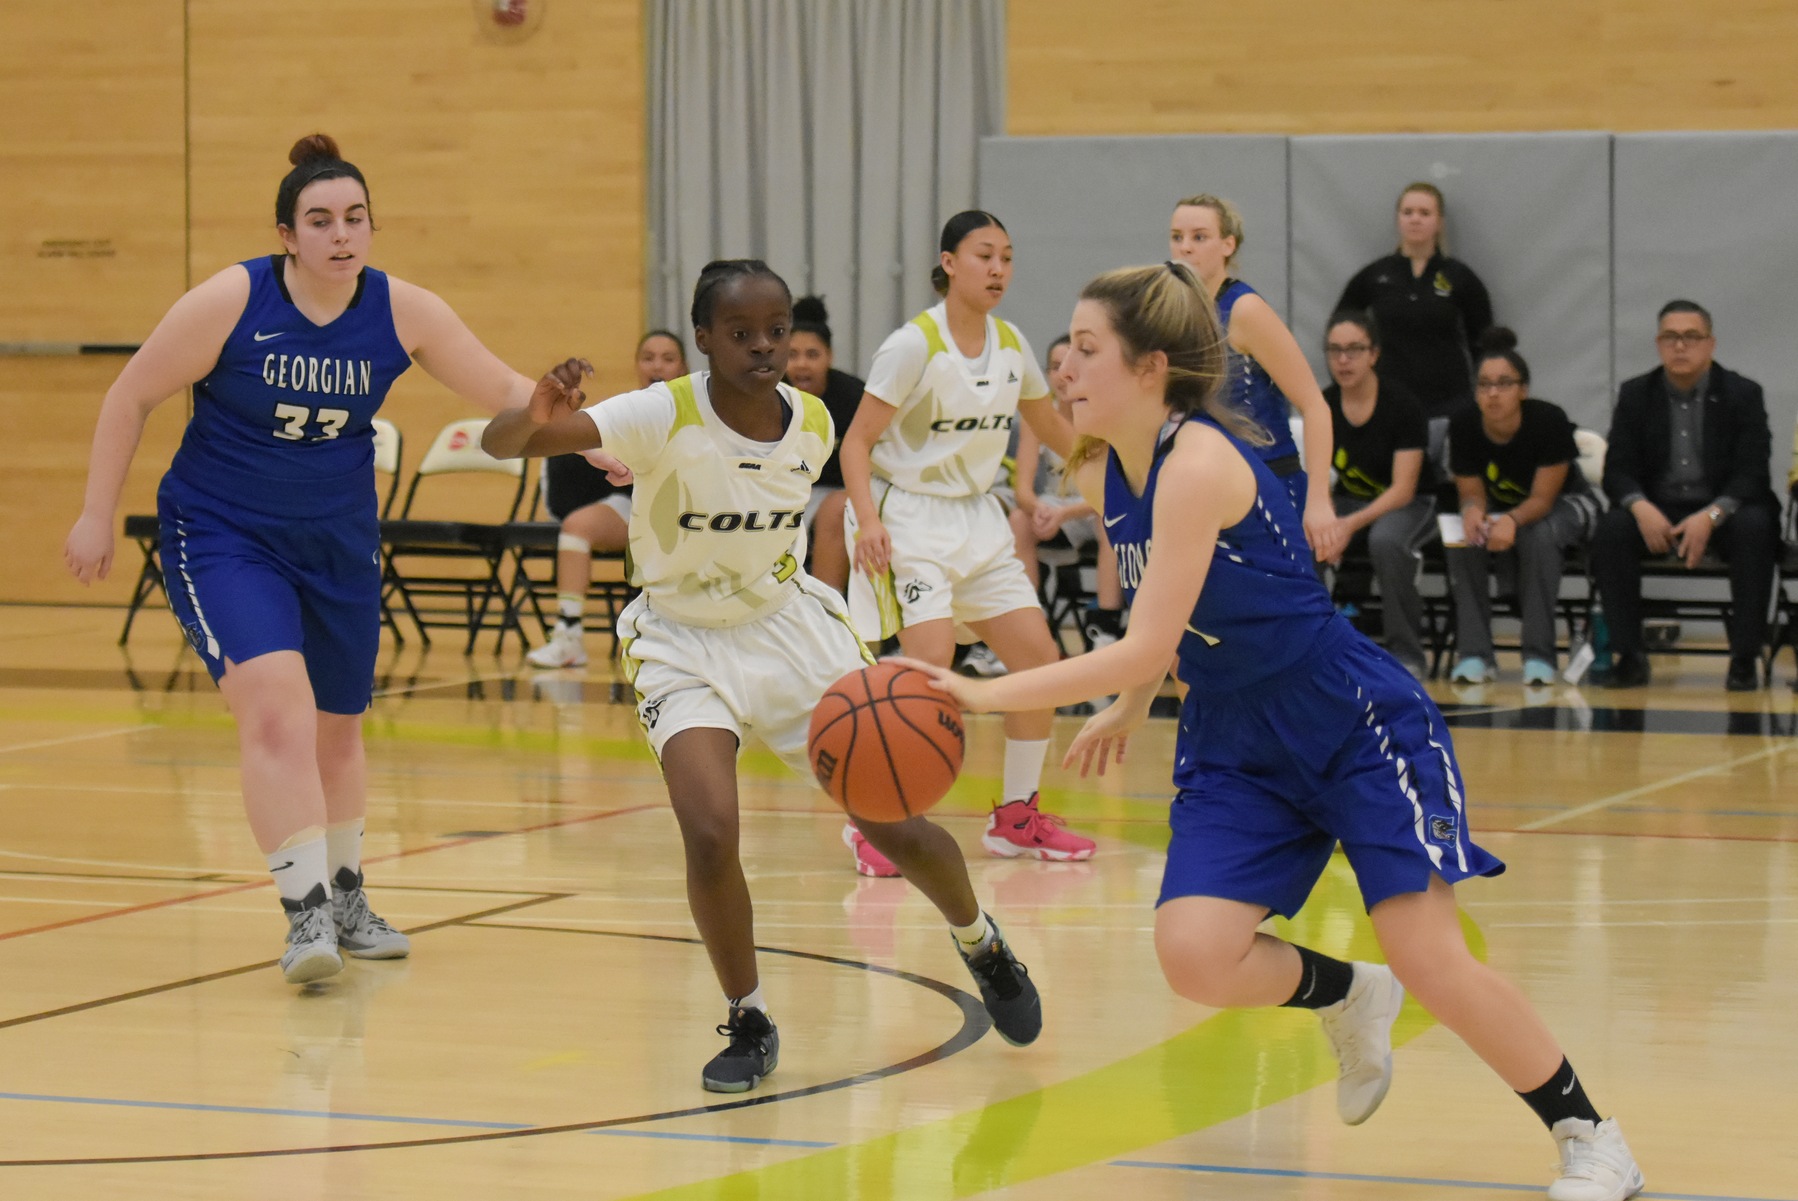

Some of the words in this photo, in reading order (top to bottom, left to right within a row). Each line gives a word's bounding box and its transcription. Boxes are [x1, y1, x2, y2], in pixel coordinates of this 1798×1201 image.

[262, 352, 371, 395] GEORGIAN
[272, 402, 350, 441] 33
[930, 413, 1014, 433] COLTS
[677, 509, 805, 533] COLTS
